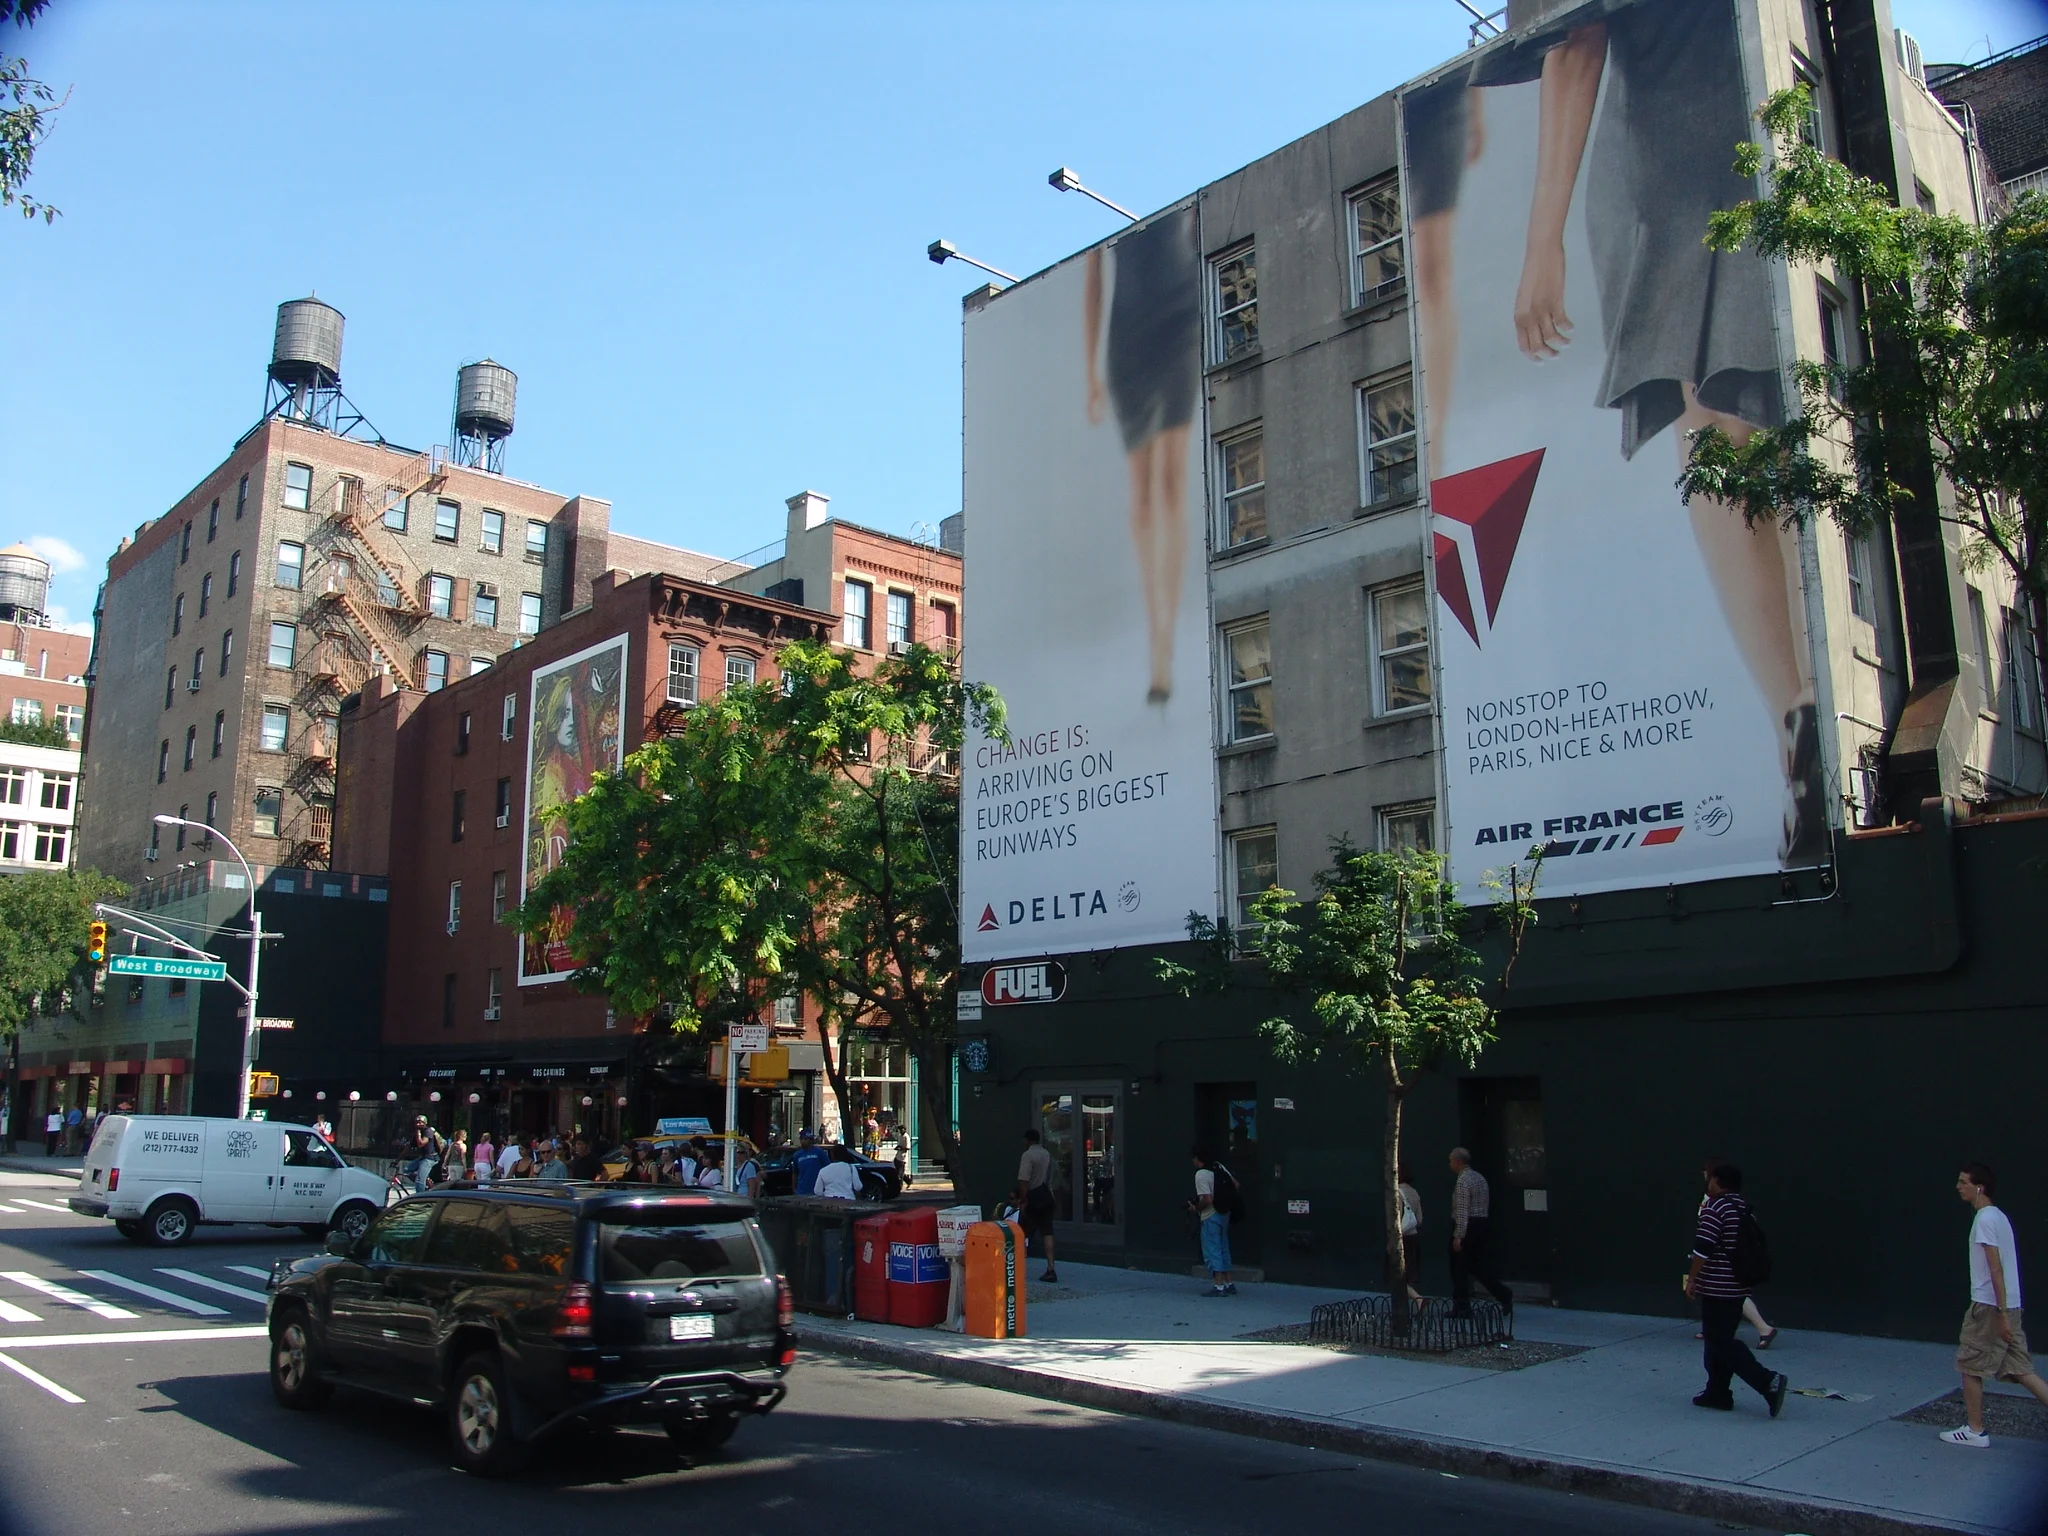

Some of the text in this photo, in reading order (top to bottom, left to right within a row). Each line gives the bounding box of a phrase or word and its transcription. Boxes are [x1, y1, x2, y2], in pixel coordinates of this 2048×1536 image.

[1466, 681, 1607, 725] NONSTOP TO
[1467, 688, 1714, 750] LONDON-HEATHROW,
[976, 724, 1089, 769] CHANGE IS:
[1469, 719, 1693, 775] PARIS, NICE & MORE
[977, 750, 1113, 800] ARRIVING ON
[977, 772, 1169, 830] EUROPE'S BIGGEST
[1694, 795, 1724, 831] SKYTEAM
[1474, 800, 1684, 846] AIR FRANCE
[977, 823, 1077, 861] RUNWAYS
[1009, 889, 1107, 925] DELTA
[116, 959, 219, 978] West Broadway
[994, 965, 1053, 1001] FUEL
[263, 1019, 294, 1029] BROADWAY
[731, 1027, 743, 1037] NO
[533, 1068, 542, 1077] DOS
[142, 1143, 199, 1154] (212) 777-4332
[144, 1130, 199, 1142] WE DELIVER
[227, 1130, 253, 1140] SOHO
[892, 1244, 914, 1258] VOICE
[920, 1246, 942, 1259] VOIC
[1006, 1252, 1015, 1287] metro
[1006, 1295, 1015, 1330] metro
